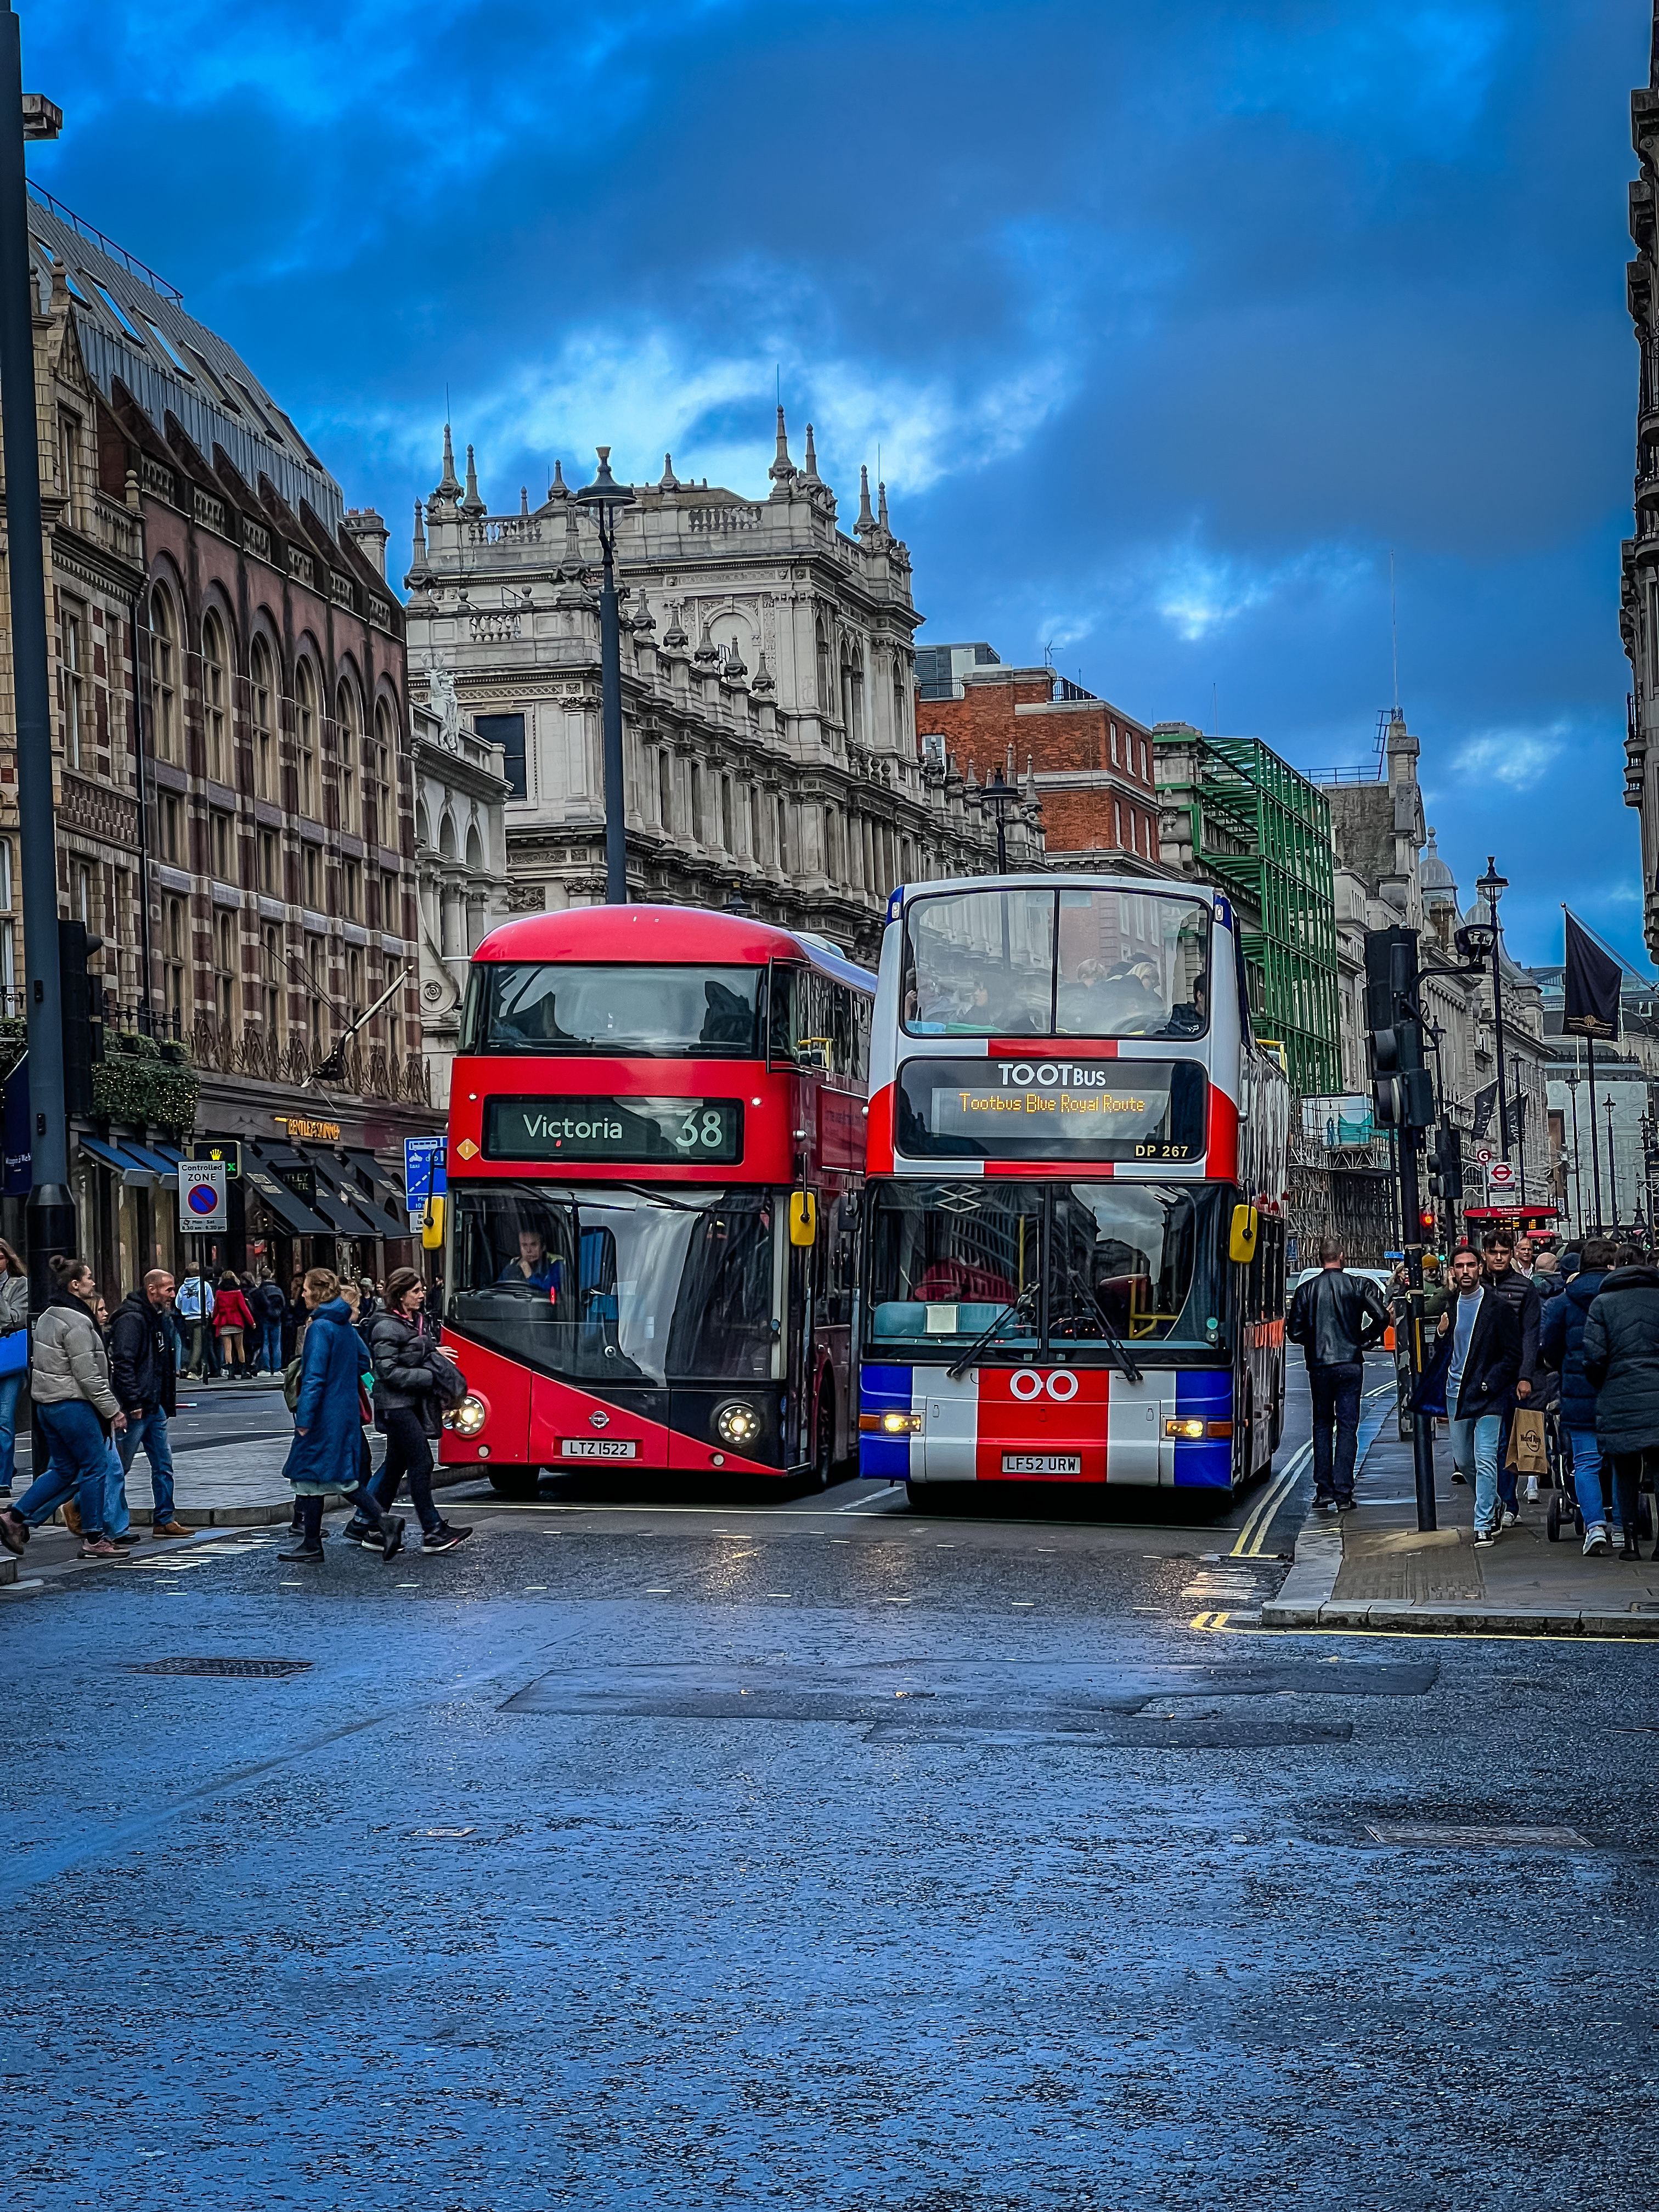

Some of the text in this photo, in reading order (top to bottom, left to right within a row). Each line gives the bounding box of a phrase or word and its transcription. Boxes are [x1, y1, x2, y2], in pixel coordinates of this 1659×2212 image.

[998, 1063, 1106, 1087] TOOTBUS
[958, 1092, 1146, 1114] Tootbus Blue Royal Route
[522, 1110, 722, 1147] Victoria 38
[1136, 1145, 1188, 1157] DP 267
[1479, 1150, 1488, 1161] G
[227, 1163, 236, 1171] X
[188, 1173, 217, 1182] ZONE
[570, 1442, 628, 1455] LTZ 1522
[1007, 1457, 1076, 1471] LF52 URW
